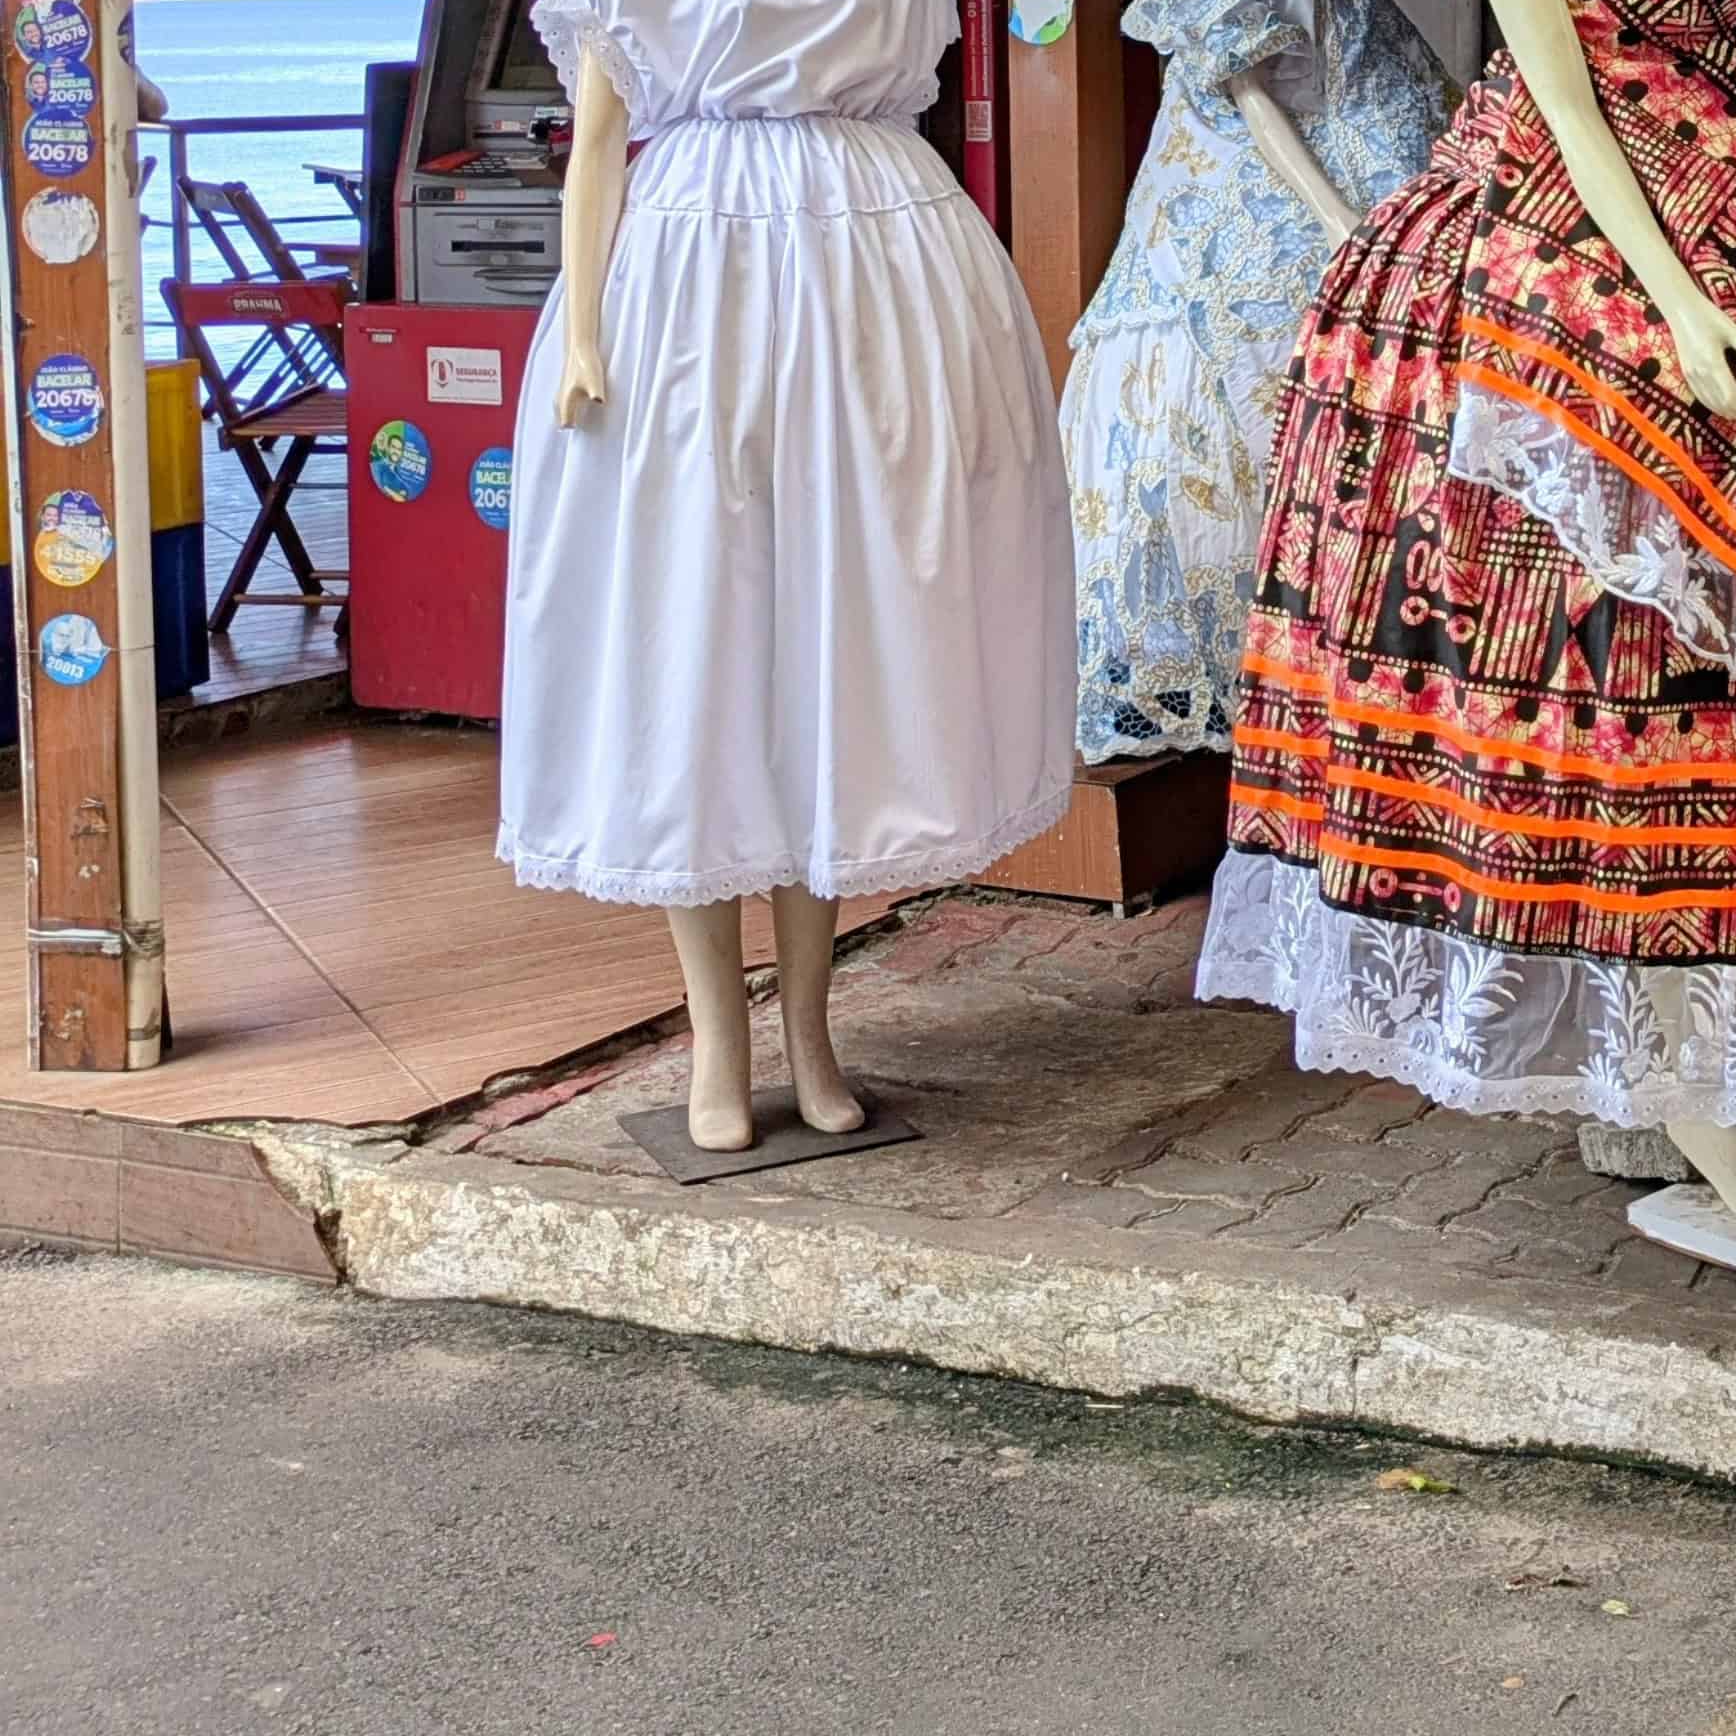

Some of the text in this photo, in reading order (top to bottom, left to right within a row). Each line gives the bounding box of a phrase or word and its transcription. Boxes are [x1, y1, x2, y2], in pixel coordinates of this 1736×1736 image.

[44, 25, 88, 49] 20678
[48, 89, 94, 104] 20678
[28, 144, 90, 163] 20678
[232, 298, 283, 313] BRAHMA
[36, 373, 93, 389] BACELAR
